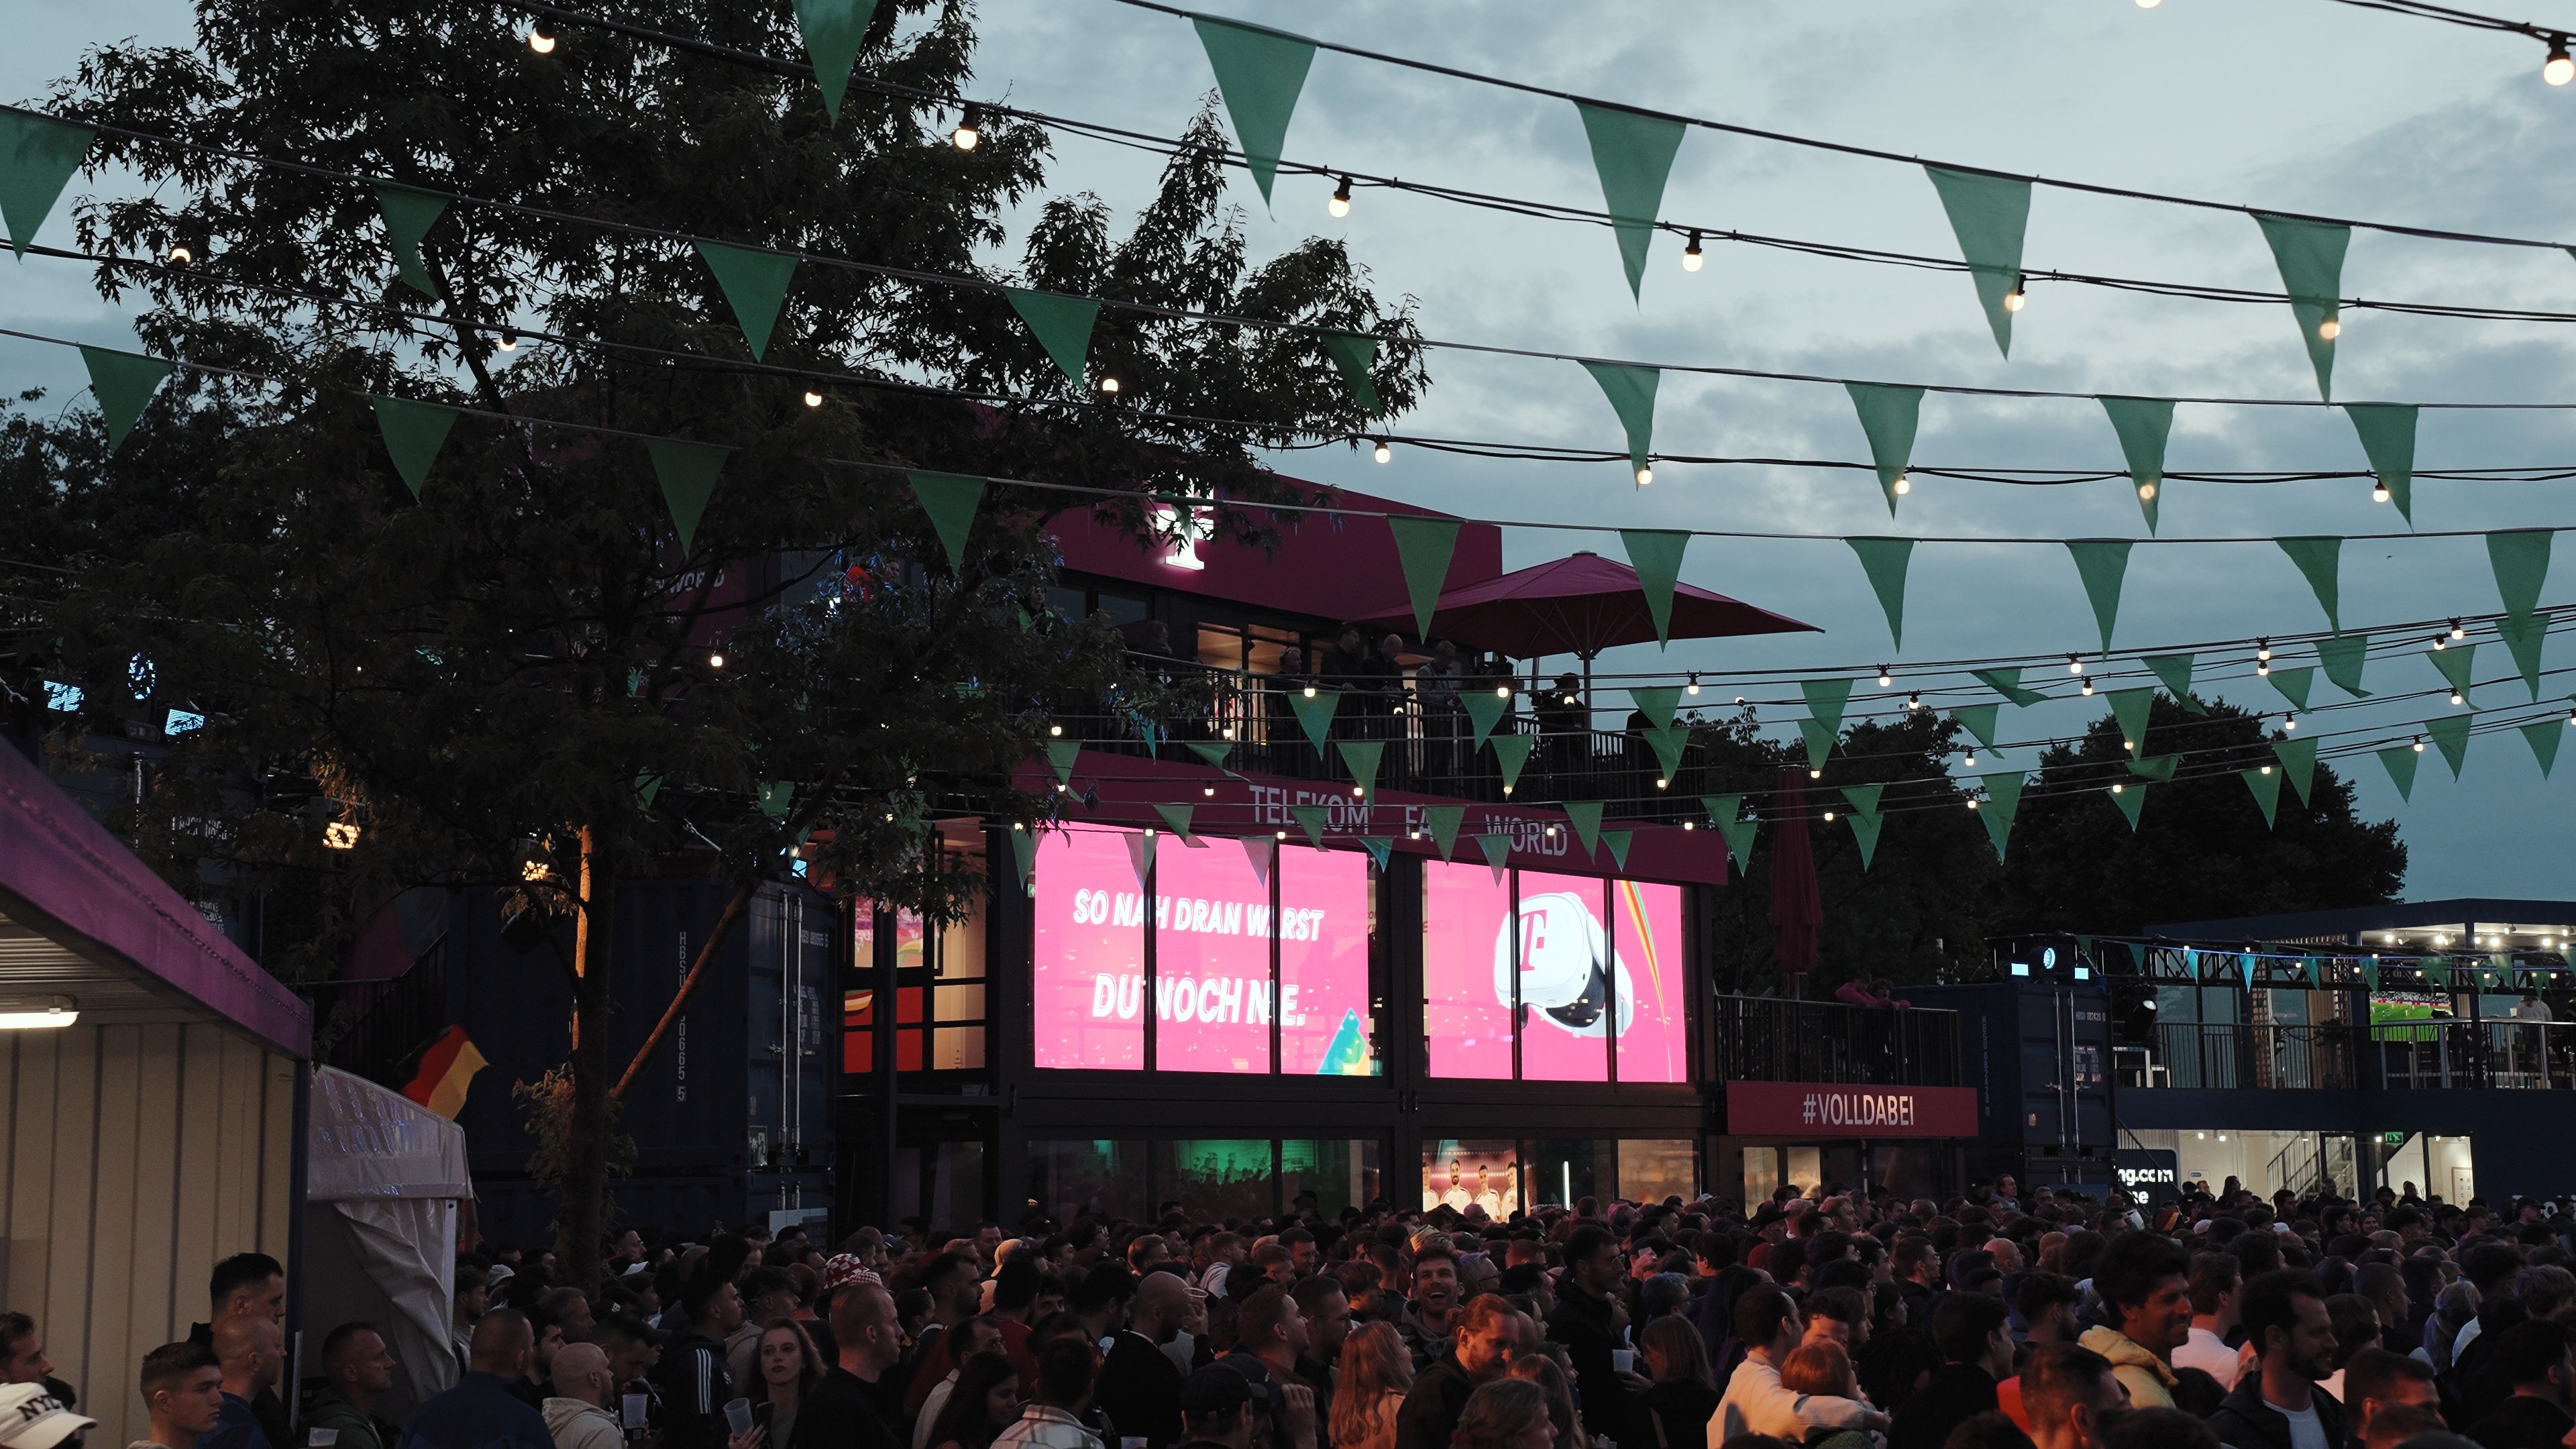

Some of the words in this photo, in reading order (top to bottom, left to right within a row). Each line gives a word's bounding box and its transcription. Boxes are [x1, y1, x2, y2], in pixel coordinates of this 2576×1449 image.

[1485, 814, 1568, 856] WORLD
[1073, 888, 1108, 924] SO
[1174, 898, 1242, 935] DRAN
[1246, 904, 1324, 941] WRST
[1093, 973, 1142, 1019] DU
[1155, 977, 1243, 1023] NOCH
[1246, 979, 1305, 1026] NE.
[1803, 1093, 1914, 1126] #VOLLDABEI
[2116, 1167, 2174, 1187] ng.com
